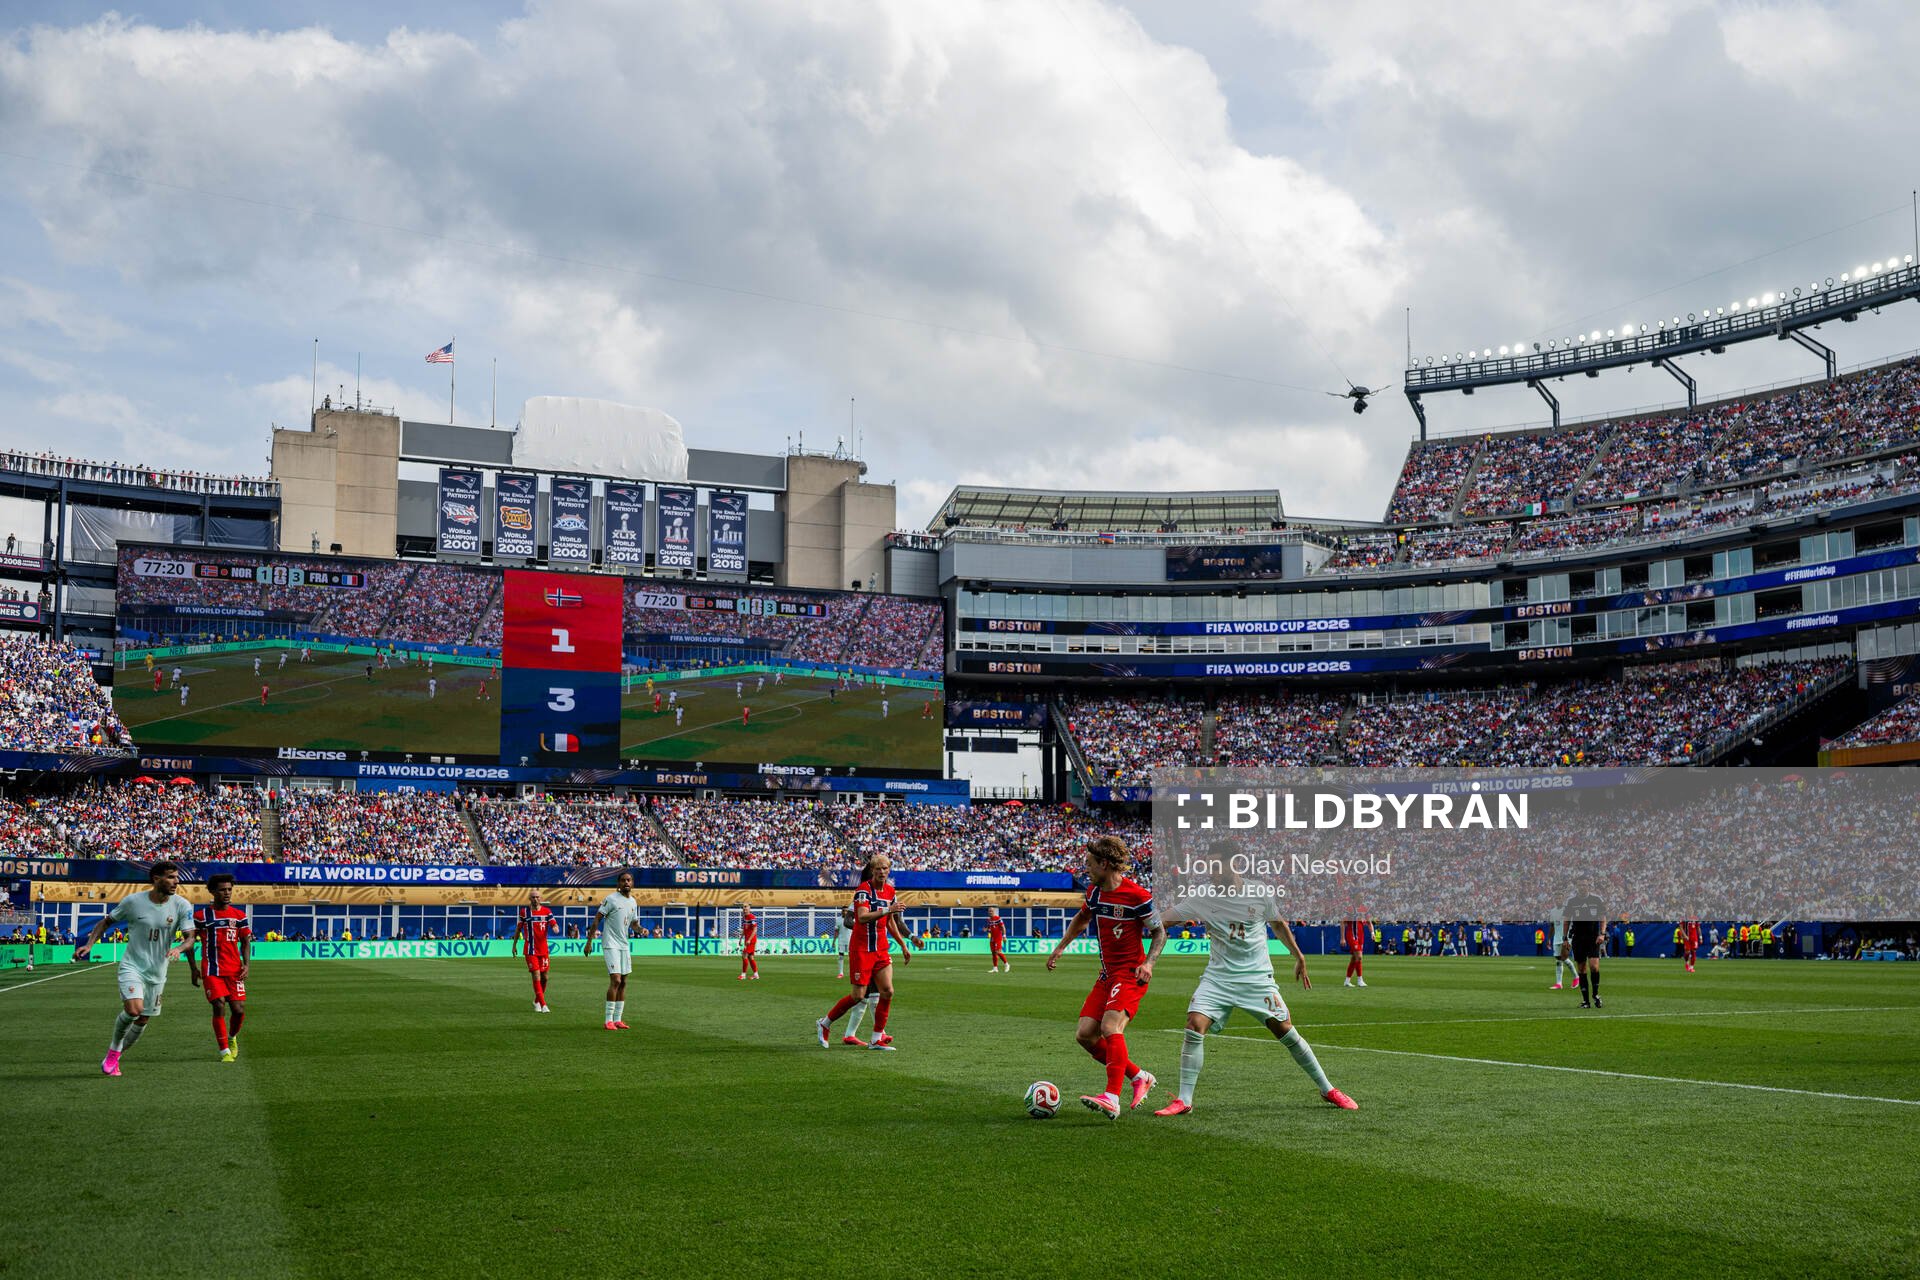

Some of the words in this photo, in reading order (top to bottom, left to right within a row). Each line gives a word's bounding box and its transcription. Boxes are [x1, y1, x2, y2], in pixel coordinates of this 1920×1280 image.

[503, 496, 530, 504] PATRIOTS
[558, 501, 585, 509] PATRIOTS
[448, 527, 471, 535] WORLD
[612, 531, 637, 540] XLIX
[442, 533, 478, 541] CHAMPIONS
[498, 537, 533, 545] CHAMPIONS
[443, 540, 476, 550] 2001
[553, 541, 588, 550] CHAMPIONS
[613, 539, 635, 547] WORLD
[498, 544, 532, 554] 2003
[553, 548, 587, 558] 2004
[607, 545, 641, 553] CHAMPIONS
[660, 549, 693, 557] CHAMPIONS
[3, 558, 22, 566] 2008
[610, 552, 639, 562] 2014
[662, 555, 691, 566] 2016
[711, 553, 744, 561] CHAMPIONS
[1203, 557, 1245, 567] BOSTON
[713, 560, 742, 569] 2018
[143, 561, 185, 575] 77:20
[231, 567, 252, 579] NOR
[261, 570, 267, 580] 1
[292, 572, 300, 582] 3
[309, 572, 329, 584] FRA
[1784, 566, 1836, 582] #FIFAWorldCup
[643, 594, 677, 607] 77:20
[716, 600, 734, 609] NOR
[741, 602, 746, 611] 1
[767, 603, 773, 612] 3
[780, 604, 797, 614] FRA
[1517, 602, 1571, 617] BOSTON
[192, 607, 221, 615] WORLD
[989, 620, 1041, 631] BOSTON
[1206, 623, 1233, 633] FIFA
[1234, 622, 1278, 633] WORLD
[1280, 621, 1305, 632] CUP
[1307, 619, 1350, 631] 2026
[1786, 615, 1838, 630] #FIFAWorldCup
[551, 628, 576, 653] 1
[1518, 646, 1573, 661] BOSTON
[989, 662, 1041, 673] BOSTON
[1206, 664, 1233, 675] FIFA
[1234, 663, 1279, 674] WORLD
[1281, 662, 1306, 673] CUP
[1307, 661, 1351, 672] 2026
[547, 687, 576, 712] 3
[973, 709, 1022, 720] BOSTON
[278, 747, 347, 761] Hisense
[358, 764, 387, 776] FIFA
[389, 765, 436, 777] WORLD
[437, 767, 463, 778] CUP
[464, 768, 510, 779] 2026
[758, 763, 816, 776] Hisense
[656, 774, 708, 785] BOSTON
[1432, 783, 1459, 794] FIFA
[1460, 781, 1504, 792] WRLD
[1506, 780, 1530, 790] CUP
[1531, 776, 1573, 789] 2026
[885, 781, 929, 791] #FIFAWorldCup
[0, 861, 69, 876] OSTON
[284, 867, 322, 881] FIFA
[325, 867, 387, 881] WORLD
[390, 868, 423, 881] CUP
[426, 868, 484, 881] 2026
[675, 871, 741, 884] BOSTON
[966, 875, 1021, 888] #FIFAWorldCup
[148, 928, 160, 942] 19
[1113, 923, 1124, 939] 6
[1229, 923, 1245, 941] 24
[1110, 983, 1122, 998] 6
